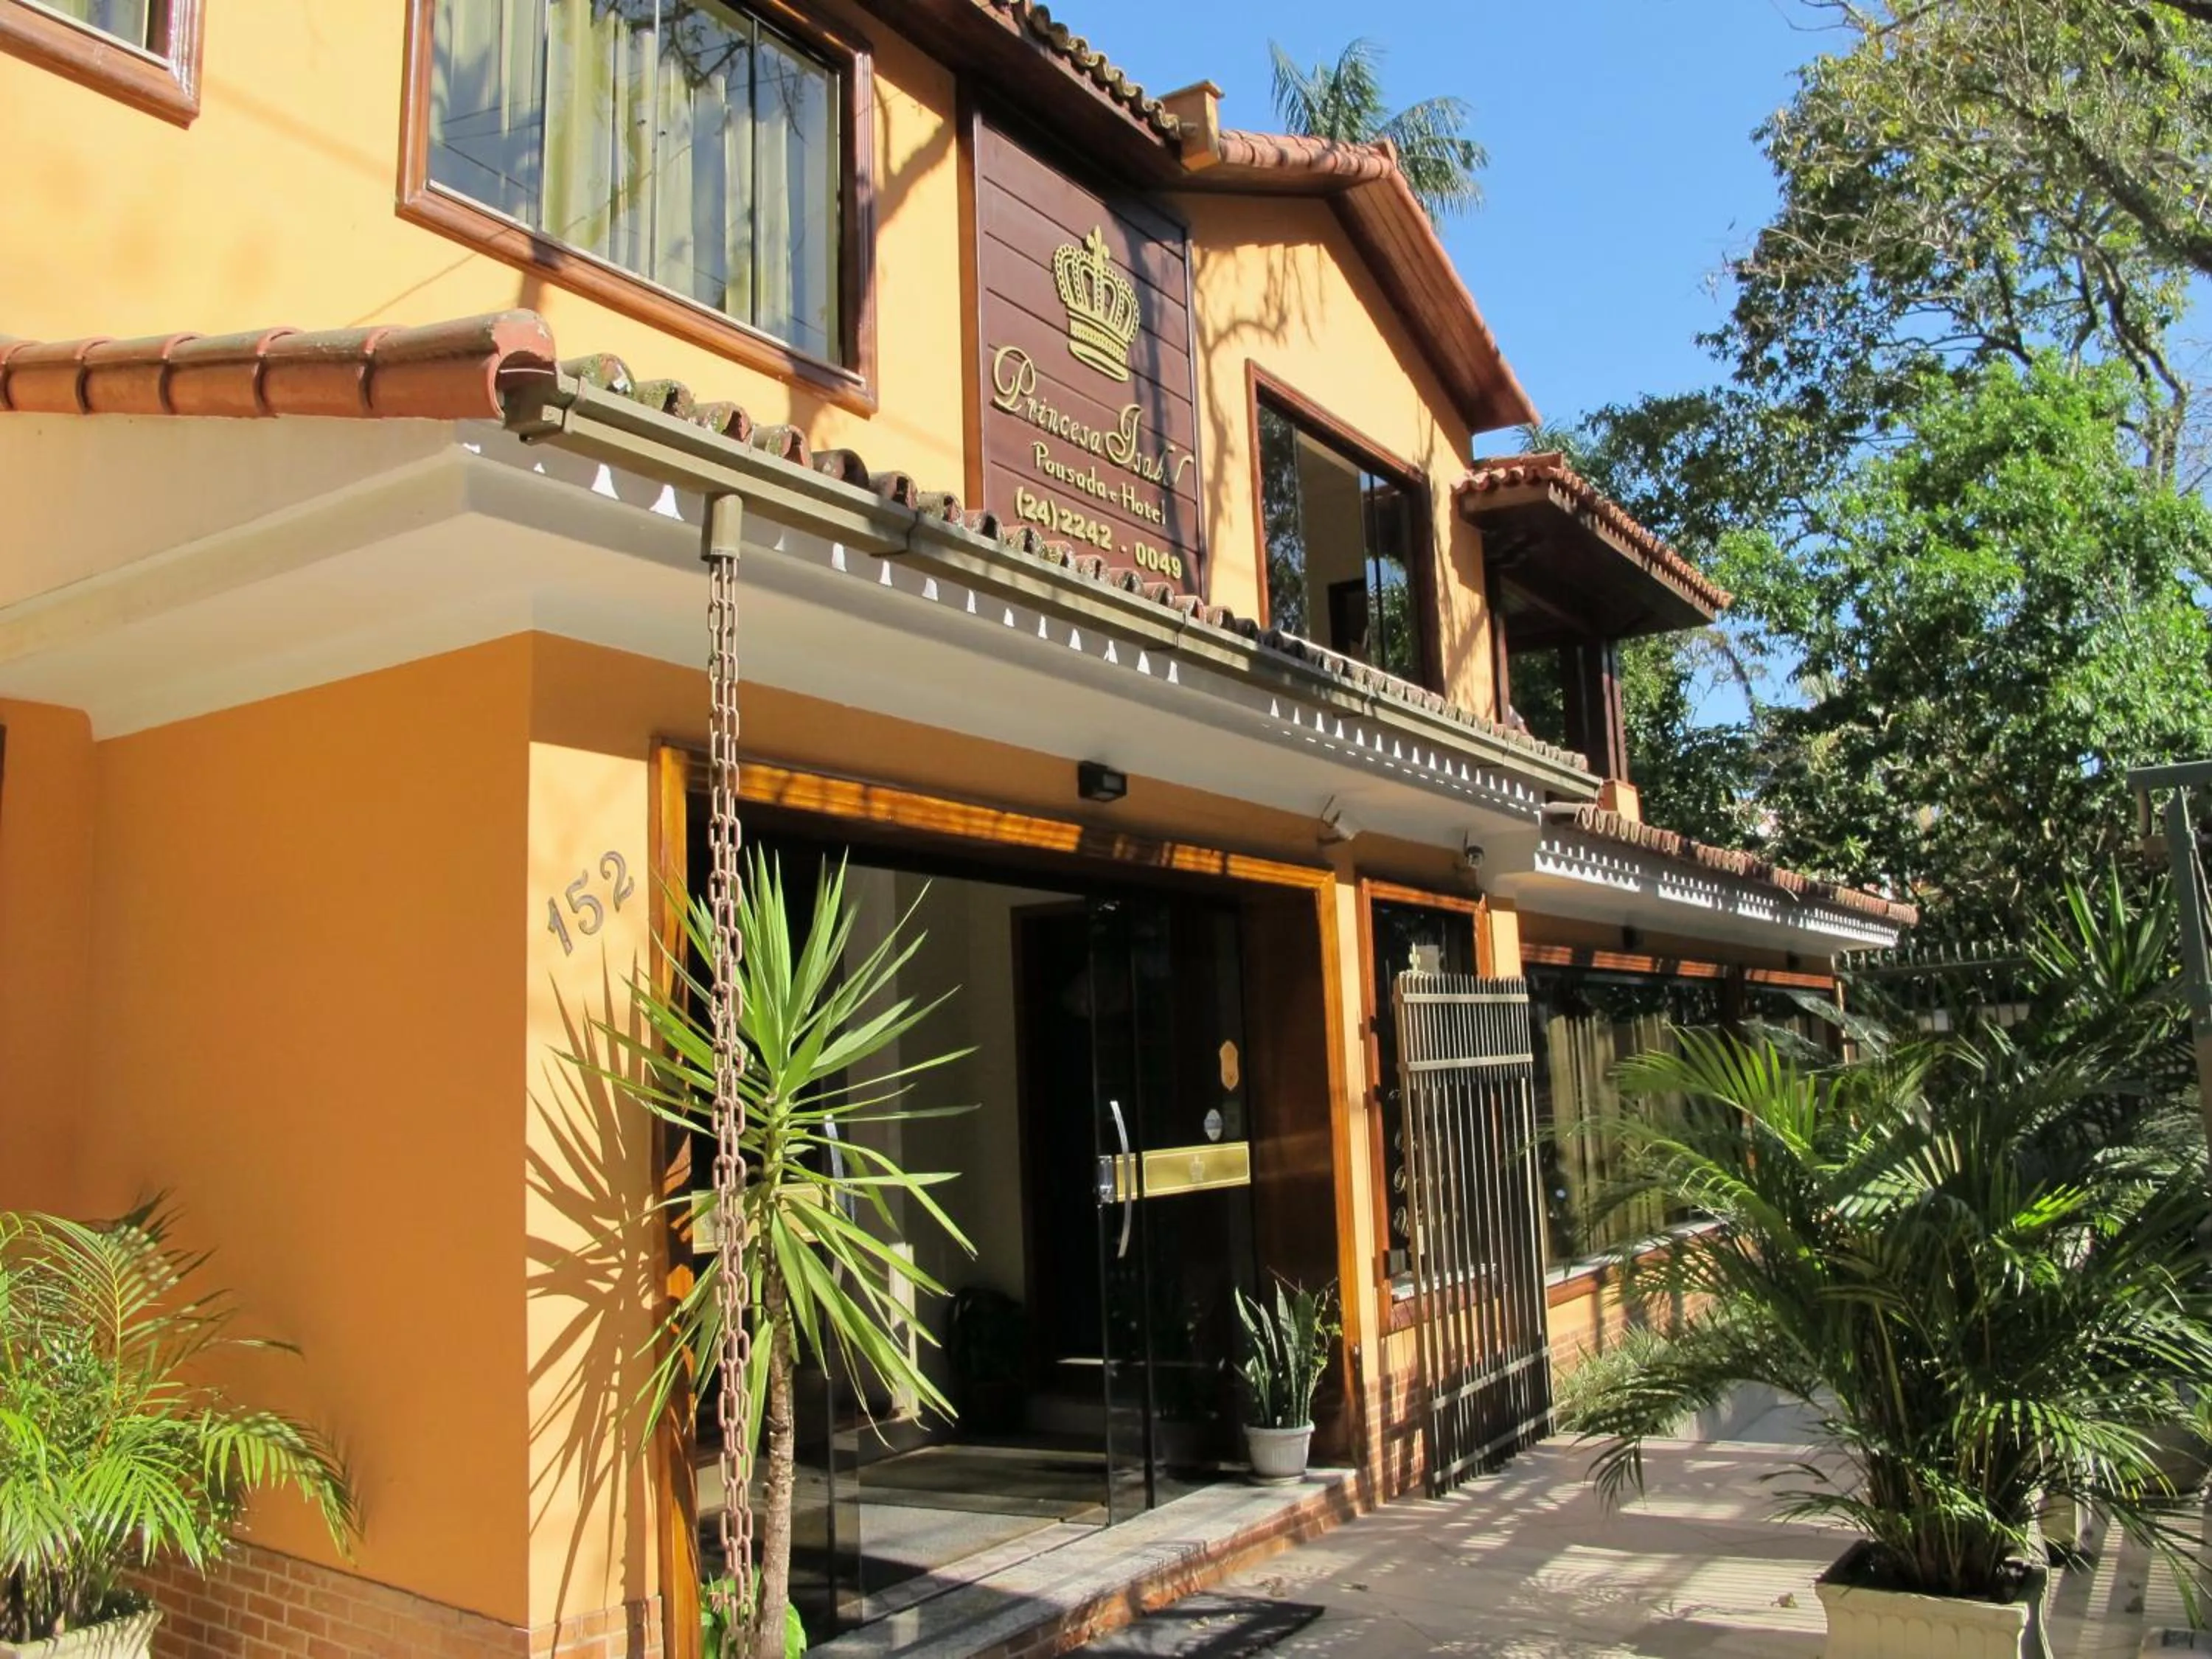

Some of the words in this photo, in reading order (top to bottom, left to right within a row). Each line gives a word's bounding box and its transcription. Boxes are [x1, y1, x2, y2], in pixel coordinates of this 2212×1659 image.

[992, 346, 1102, 453] Princesa
[1015, 487, 1057, 530] (24)
[1058, 510, 1113, 551] 2242
[1135, 543, 1183, 579] 0049
[1121, 483, 1166, 525] Hotel
[548, 851, 635, 957] 152
